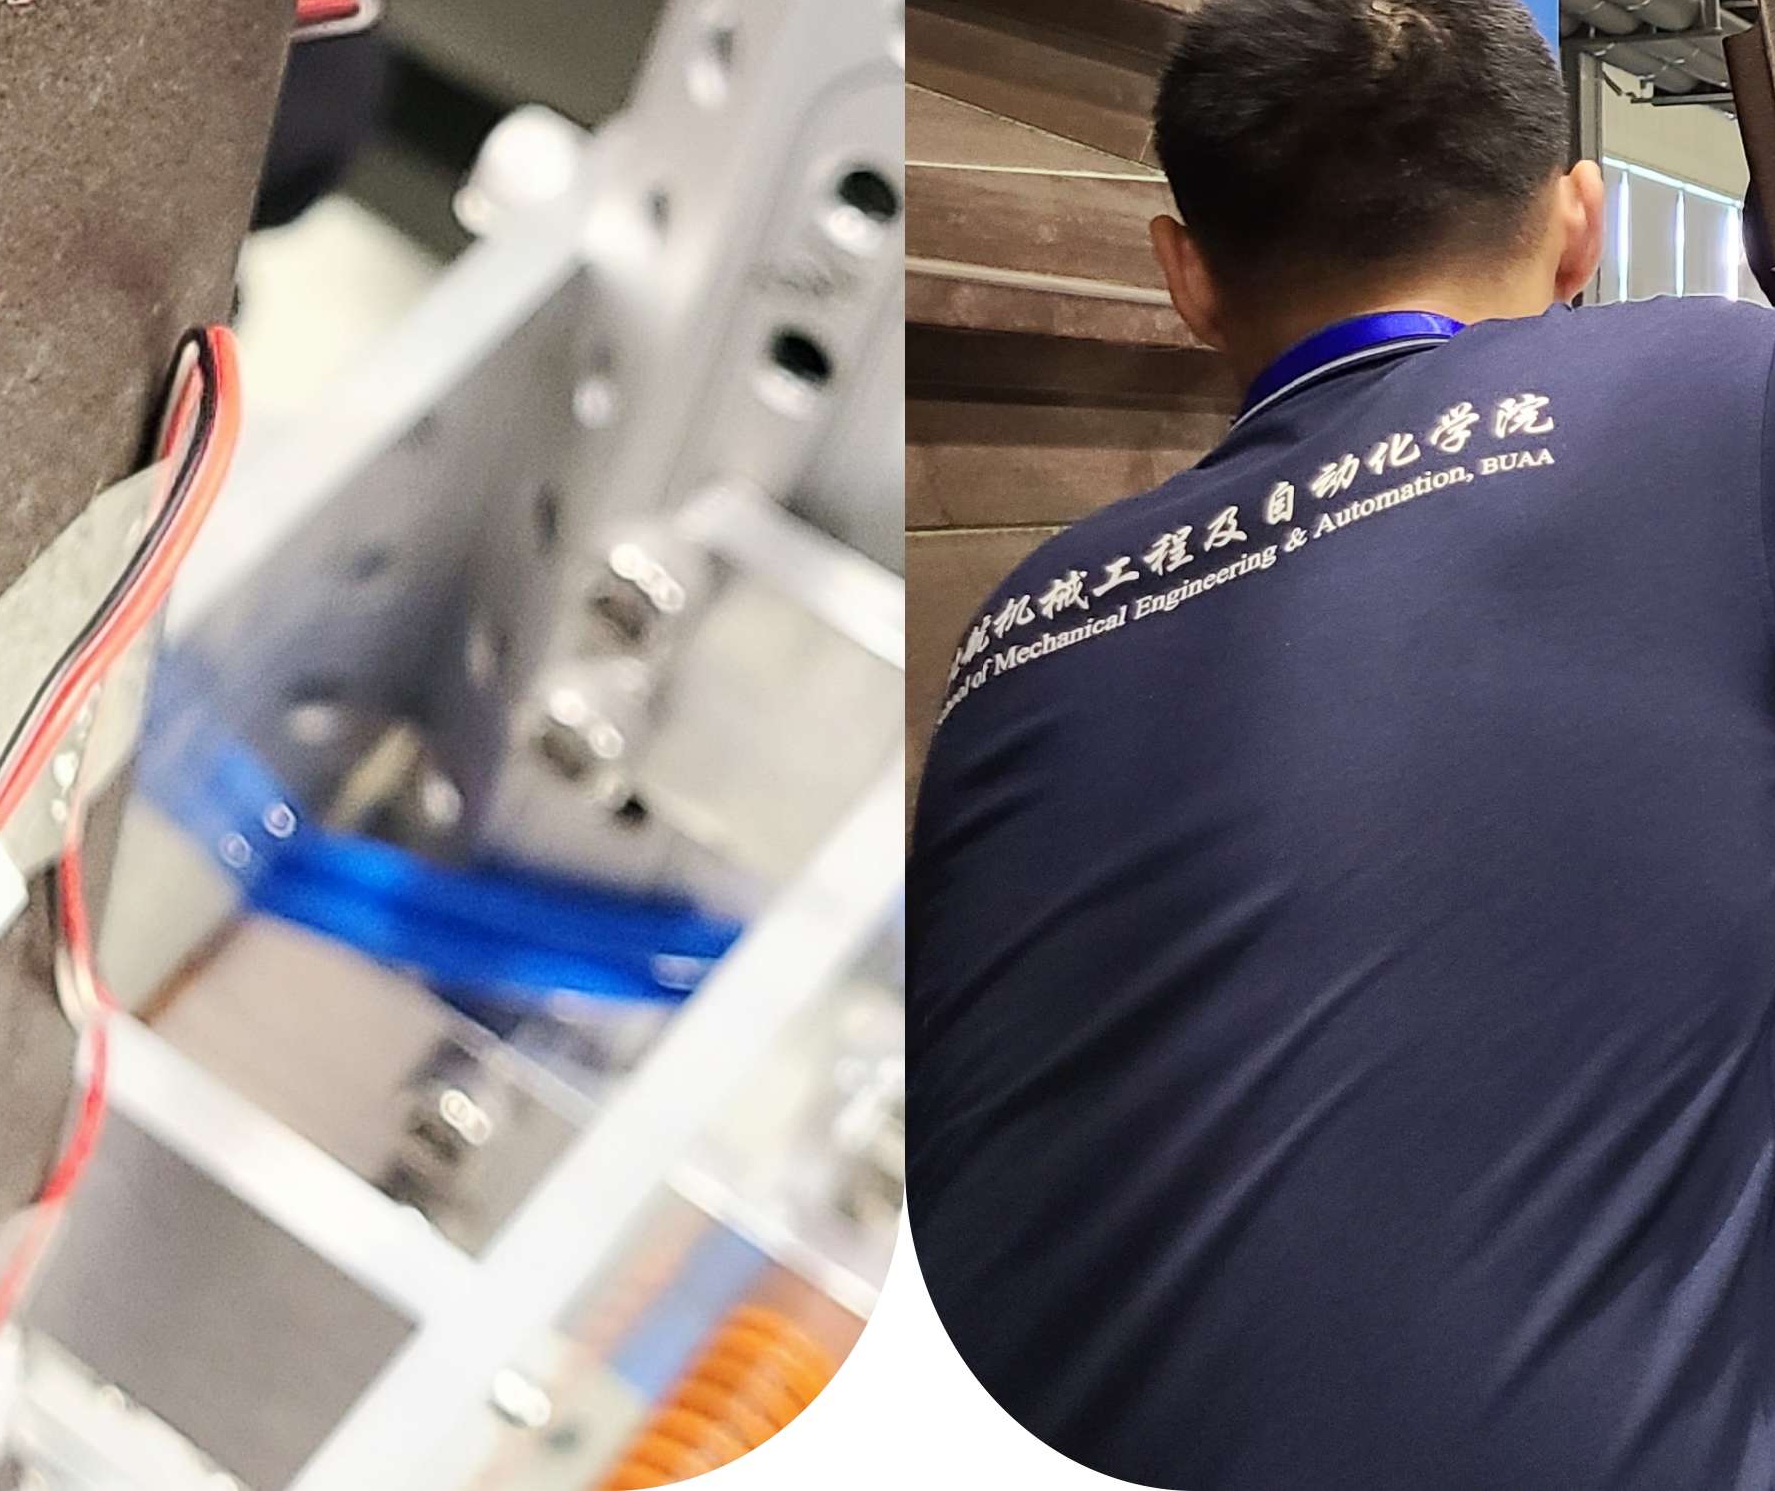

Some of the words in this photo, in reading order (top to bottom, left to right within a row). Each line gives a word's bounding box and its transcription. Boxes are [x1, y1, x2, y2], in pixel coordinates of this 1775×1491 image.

[971, 658, 994, 689] of
[994, 605, 1128, 676] Mechanical
[1134, 544, 1278, 621] Engineering
[1284, 527, 1308, 553] &
[1313, 465, 1474, 538] Automation,
[1481, 448, 1555, 476] BUAA
